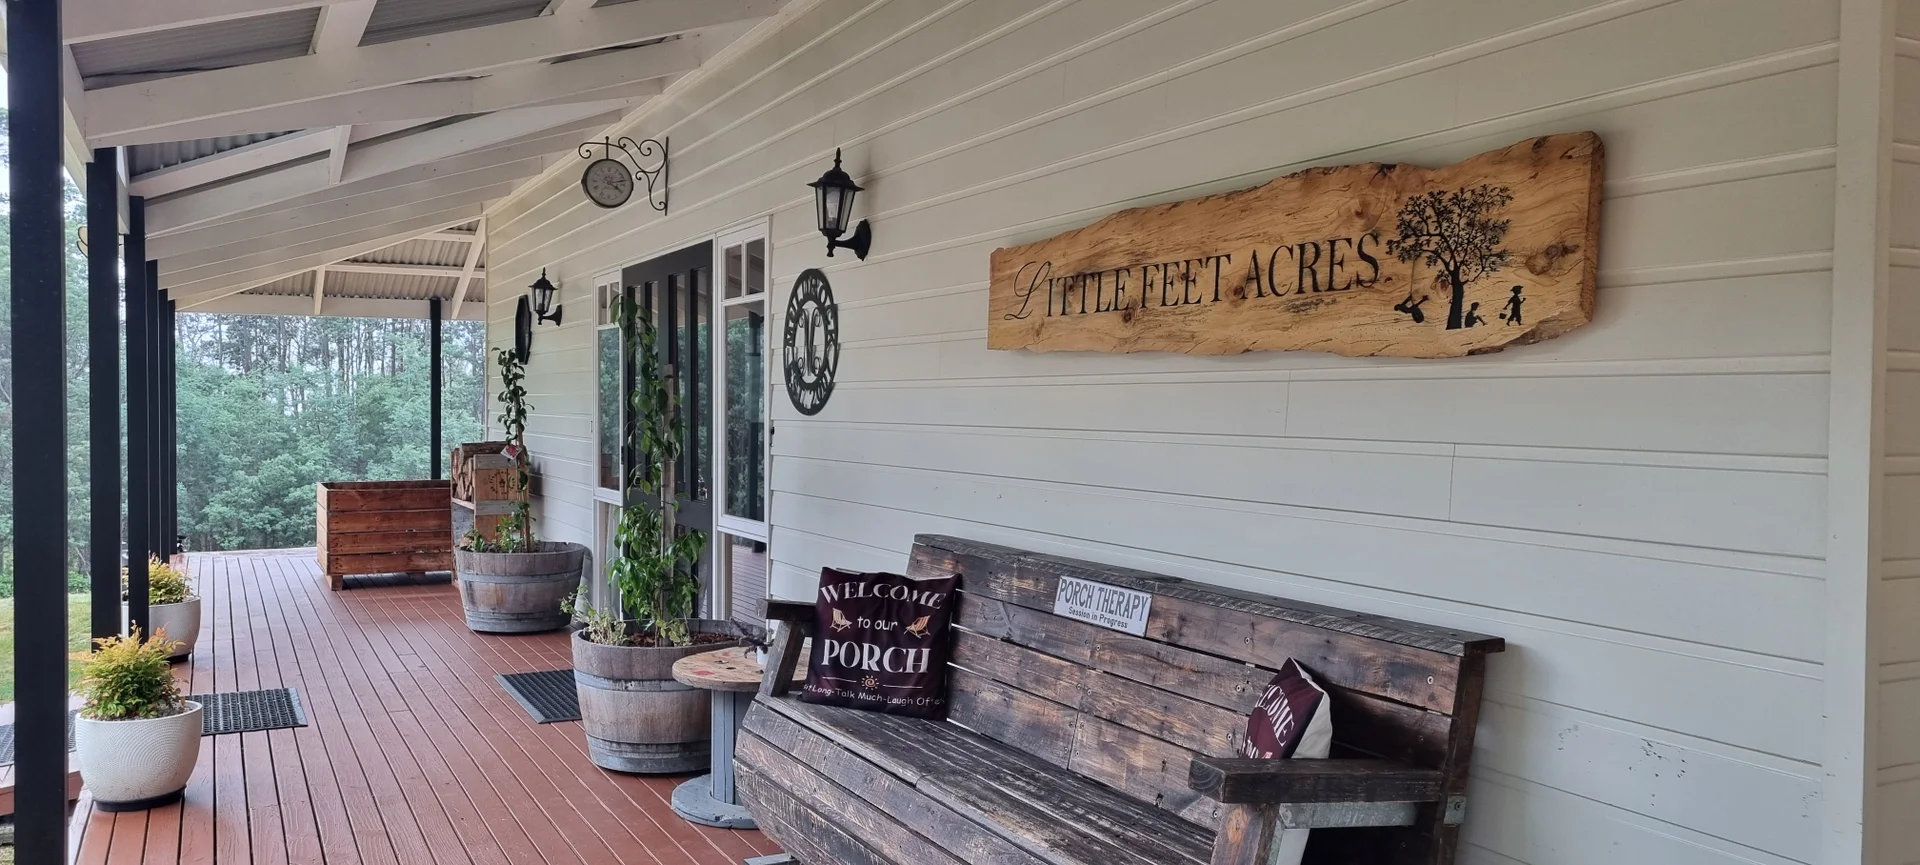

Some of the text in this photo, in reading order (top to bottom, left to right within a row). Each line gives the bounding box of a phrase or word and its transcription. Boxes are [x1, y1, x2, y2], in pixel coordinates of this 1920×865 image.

[1003, 232, 1380, 321] LITTLE FEET ACRES
[820, 581, 947, 610] WELCOME
[1057, 578, 1149, 622] PORCH THERAPY
[857, 615, 898, 631] to our
[1068, 606, 1128, 628] Session in Progress
[821, 638, 932, 674] PORCH
